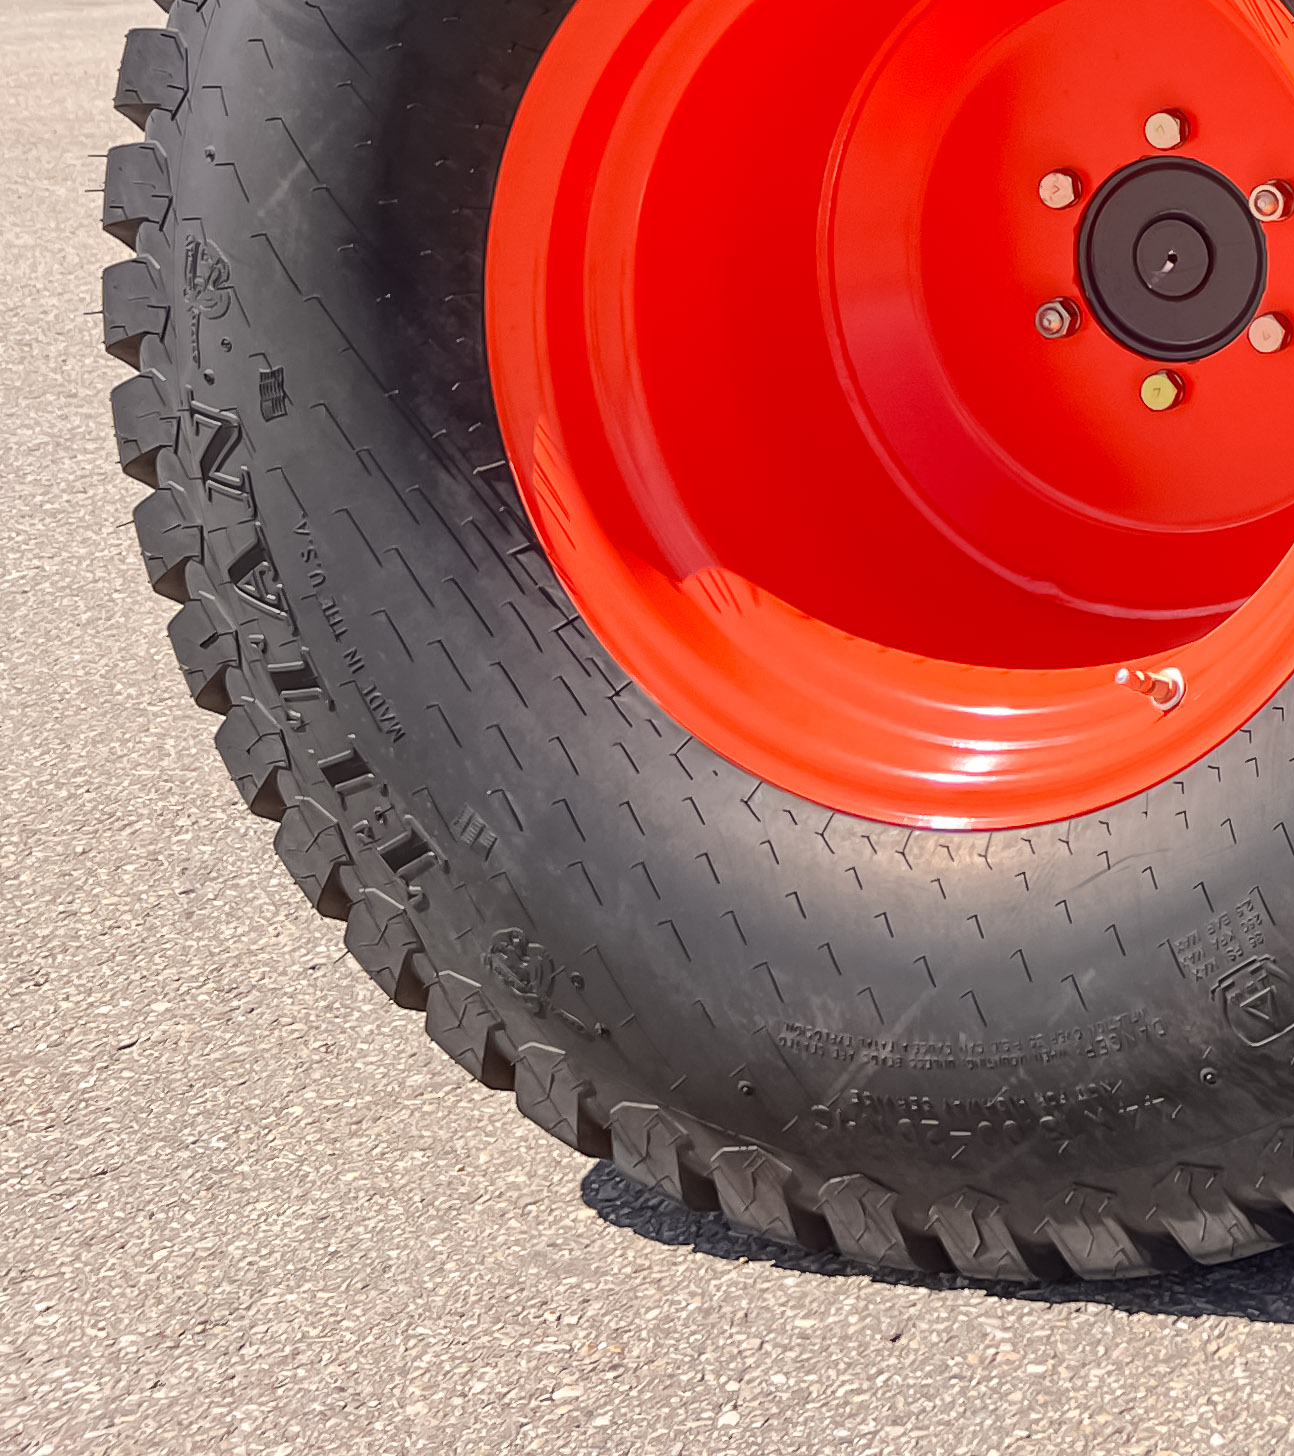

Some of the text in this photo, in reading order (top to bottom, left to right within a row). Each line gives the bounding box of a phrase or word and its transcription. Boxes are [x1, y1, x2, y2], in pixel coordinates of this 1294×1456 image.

[321, 595, 348, 642] THE
[186, 386, 450, 914] TITAN
[342, 646, 367, 674] IN
[362, 686, 406, 744] MADE
